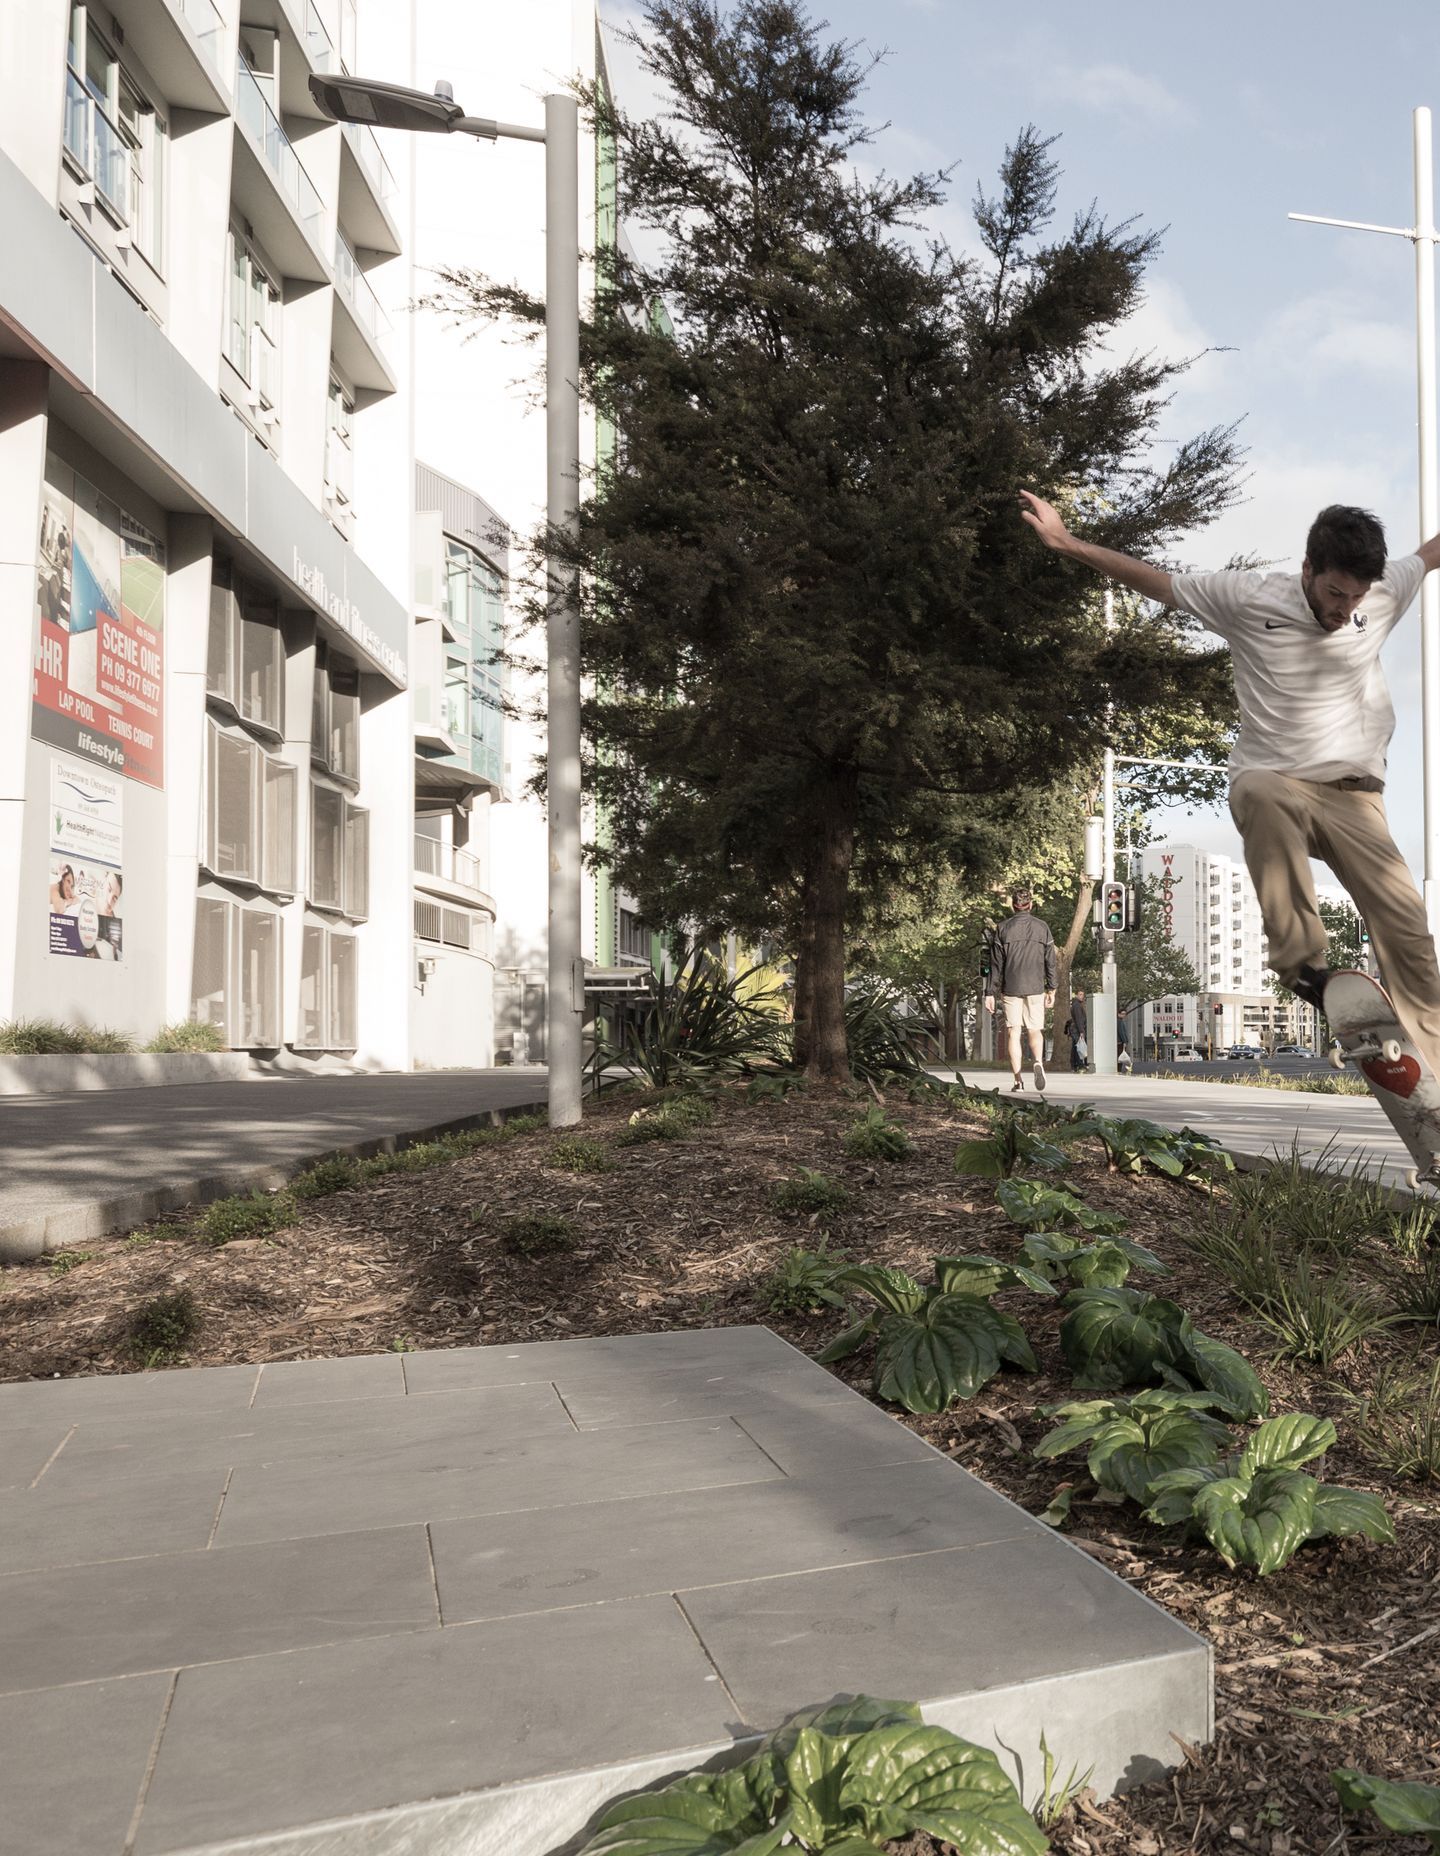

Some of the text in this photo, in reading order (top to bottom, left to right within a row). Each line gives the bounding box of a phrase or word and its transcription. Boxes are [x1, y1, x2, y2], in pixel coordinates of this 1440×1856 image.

[330, 593, 350, 632] and
[101, 653, 113, 677] PH
[114, 661, 125, 684] 09
[126, 667, 141, 692] 377
[102, 622, 161, 681] SCENE ONE
[58, 690, 154, 750] LAP POOL TENNIS COURT
